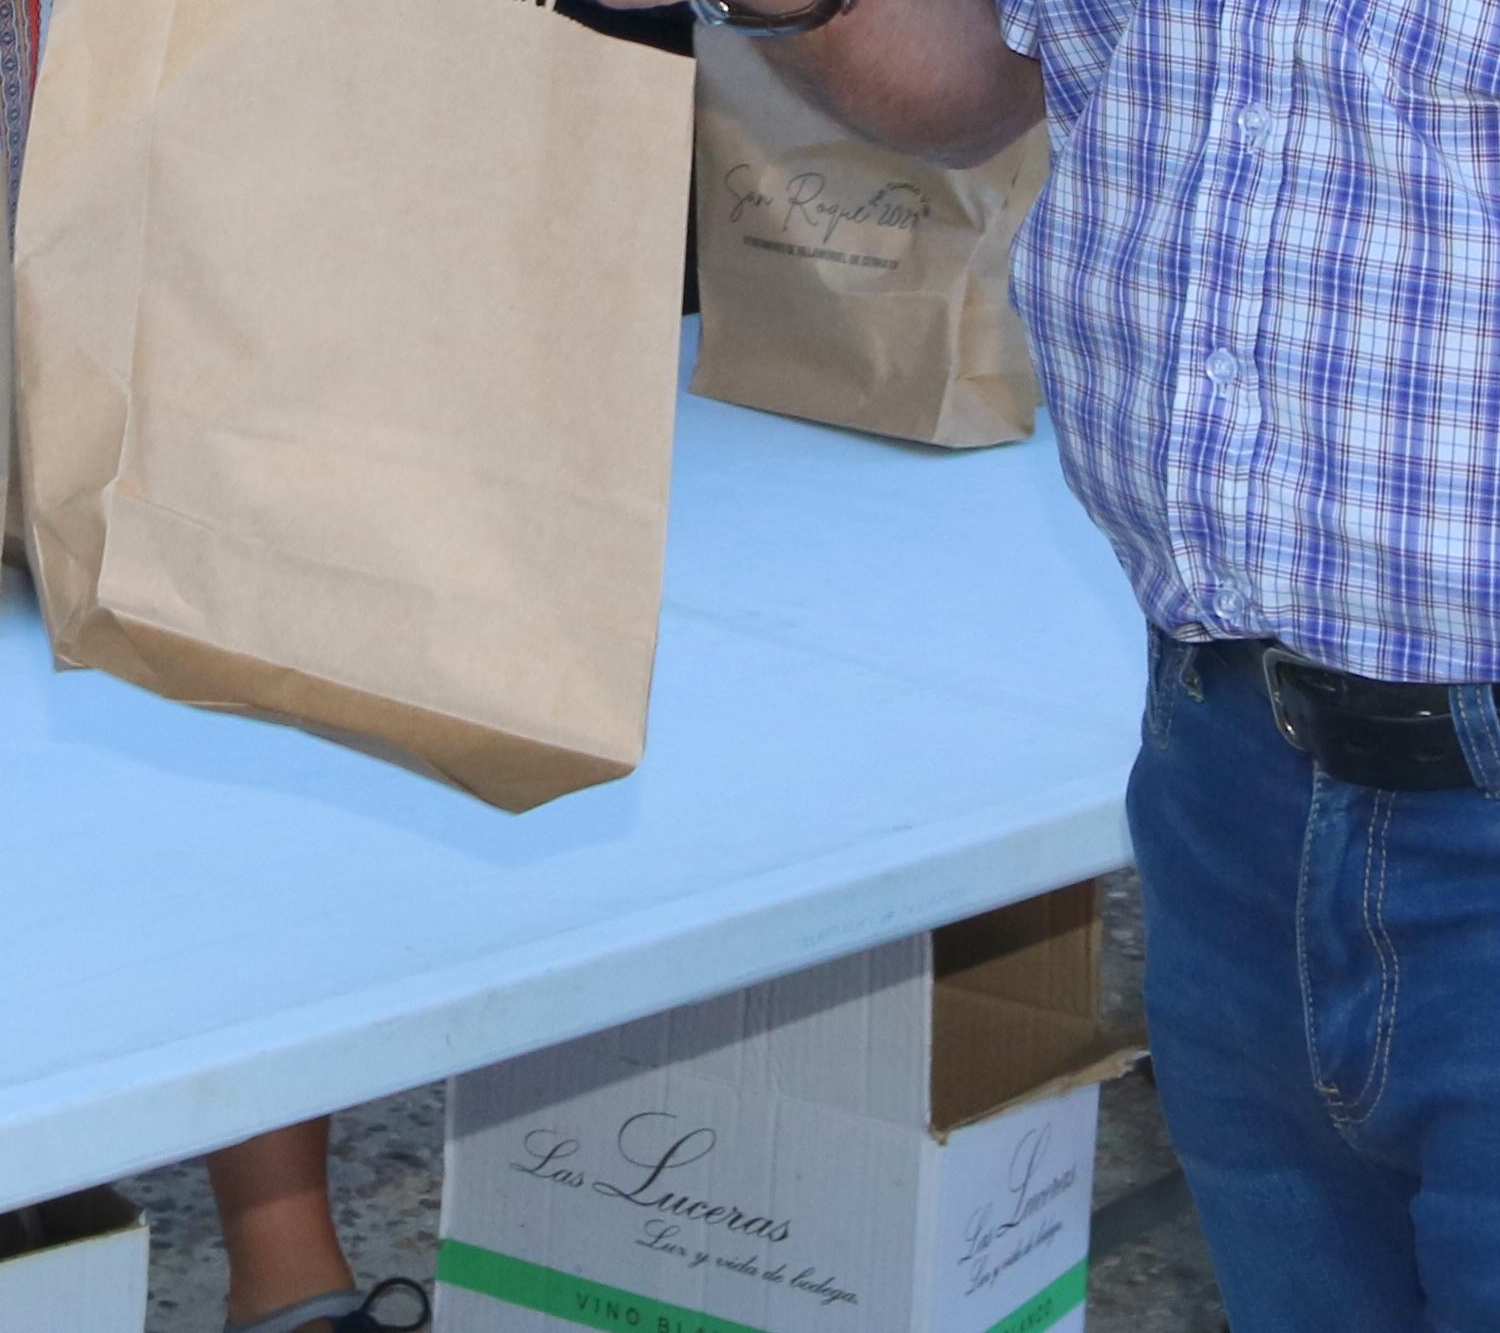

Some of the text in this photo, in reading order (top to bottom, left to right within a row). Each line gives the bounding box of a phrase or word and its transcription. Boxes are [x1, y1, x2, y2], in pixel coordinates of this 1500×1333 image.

[724, 163, 774, 223] San
[783, 172, 873, 244] Roque
[509, 1111, 792, 1243] Las Luceras
[716, 1254, 760, 1277] vida
[762, 1263, 788, 1284] de
[575, 1291, 641, 1326] VINO
